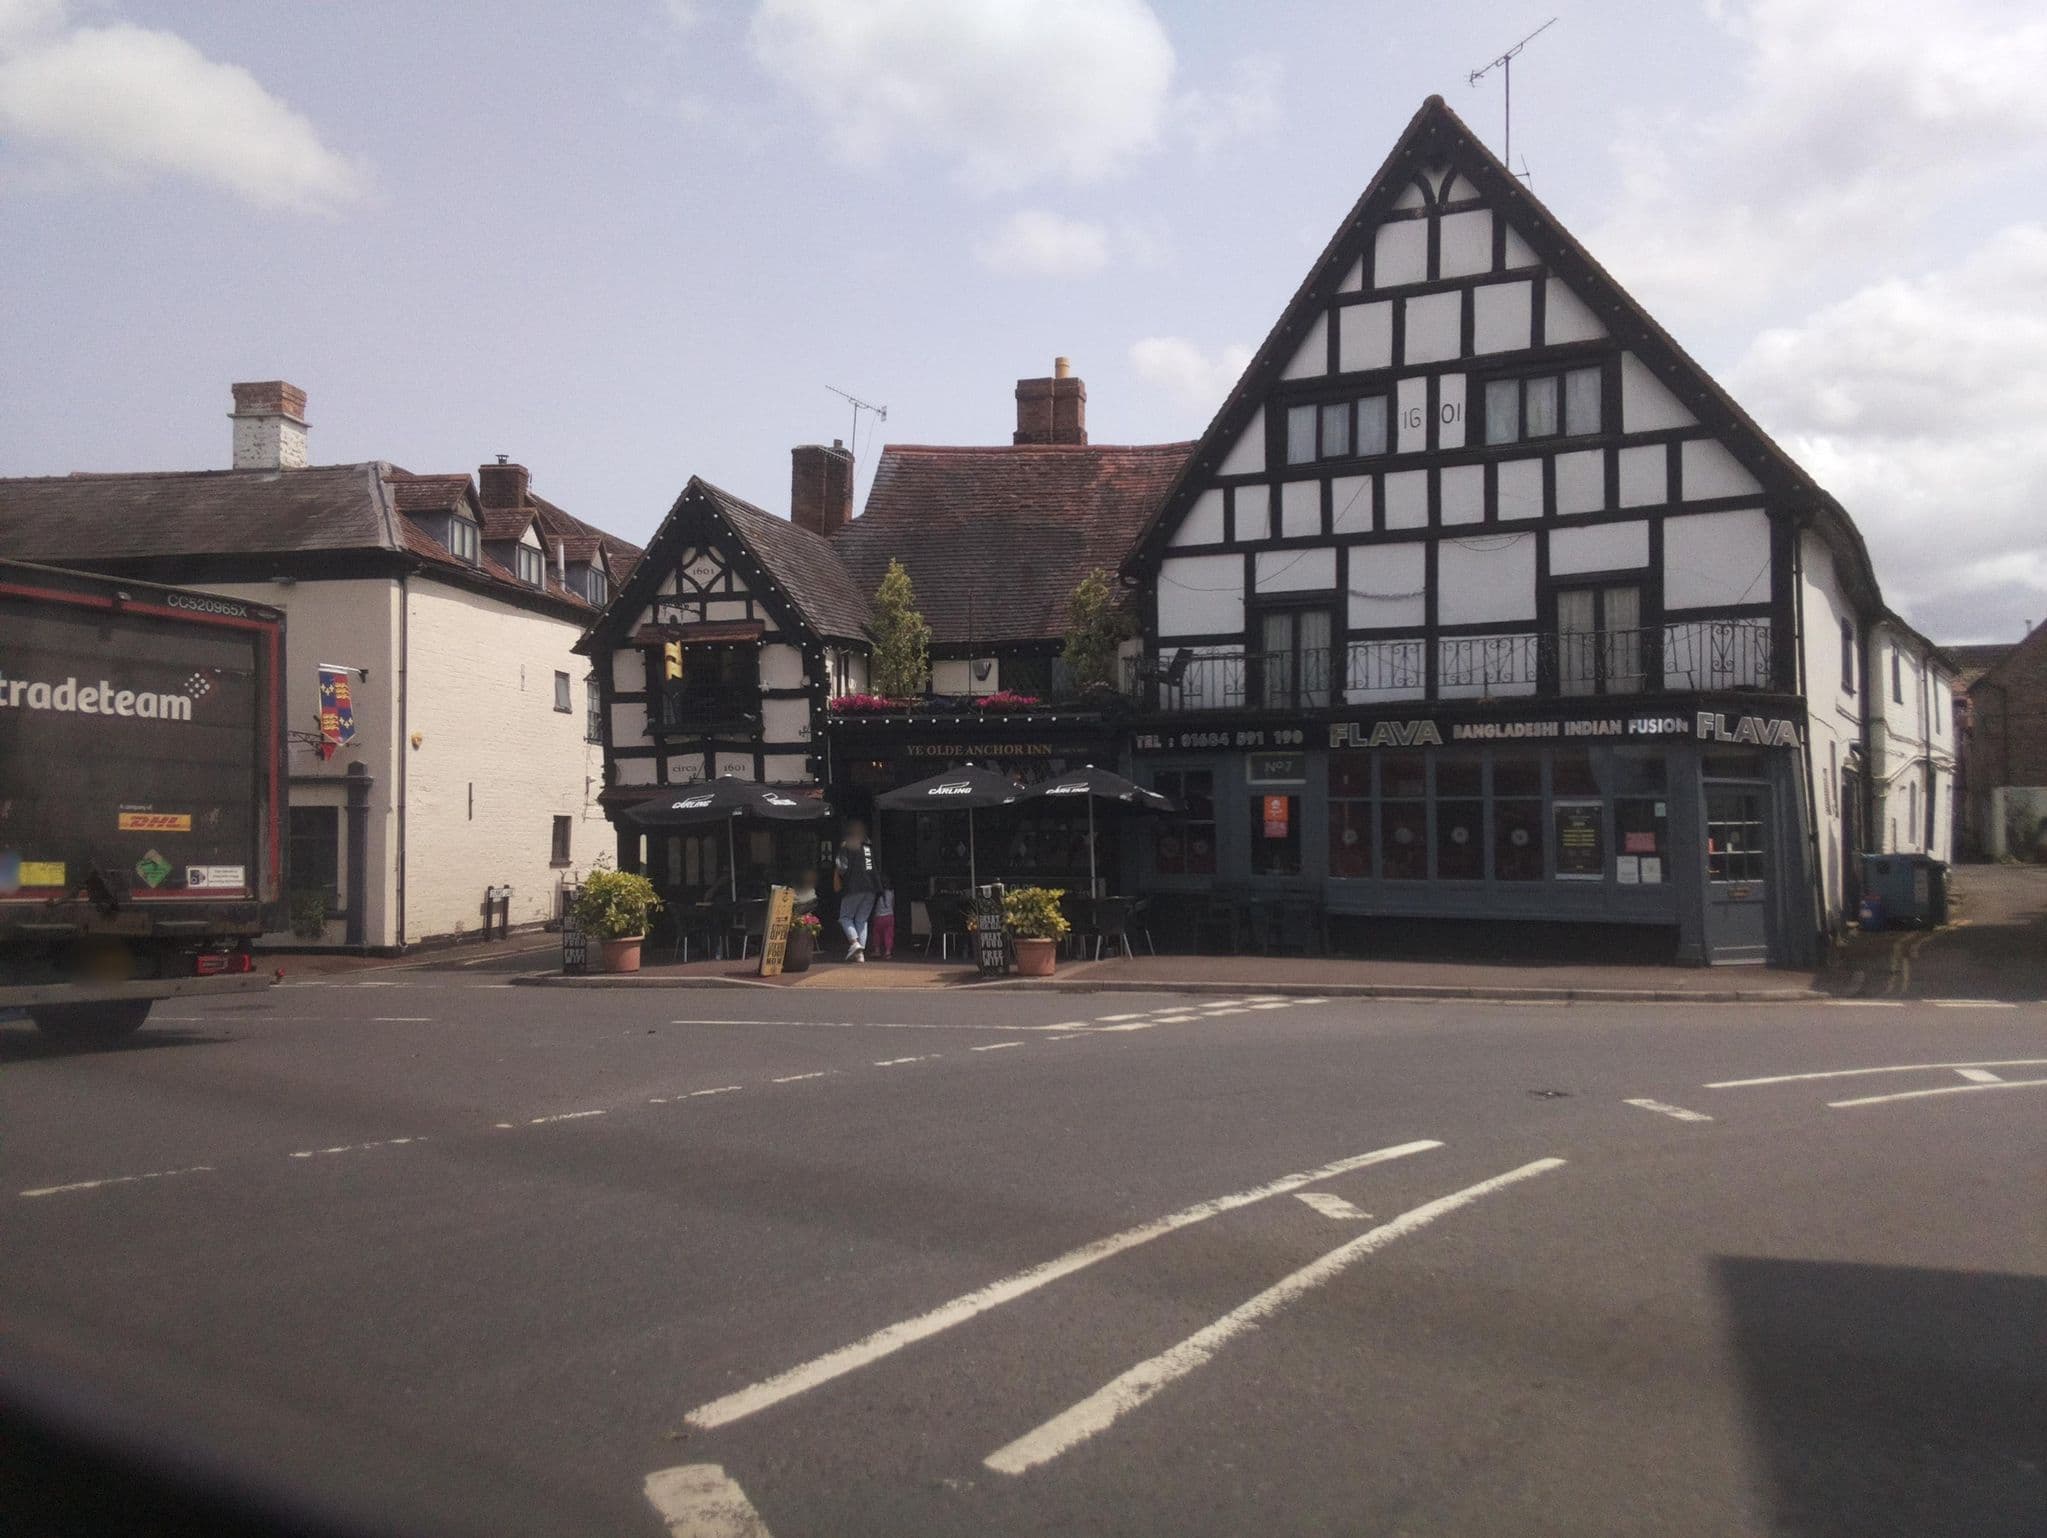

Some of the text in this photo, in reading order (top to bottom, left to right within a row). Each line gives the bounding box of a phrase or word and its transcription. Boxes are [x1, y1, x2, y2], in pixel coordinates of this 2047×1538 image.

[692, 567, 715, 576] 1601
[167, 594, 248, 617] CC520965X
[1329, 719, 1443, 748] FLAVA
[1453, 716, 1688, 740] BANGLADESHI INDIAN FUSION
[1696, 711, 1801, 748] FLAVA
[1136, 734, 1162, 749] TEL
[907, 744, 924, 756] YE
[926, 744, 964, 756] OLDE
[966, 743, 1026, 756] ANCHOR
[1027, 743, 1052, 755] INN
[672, 762, 746, 773] circa 1601
[928, 786, 973, 795] CARLING
[865, 858, 873, 871] AIR
